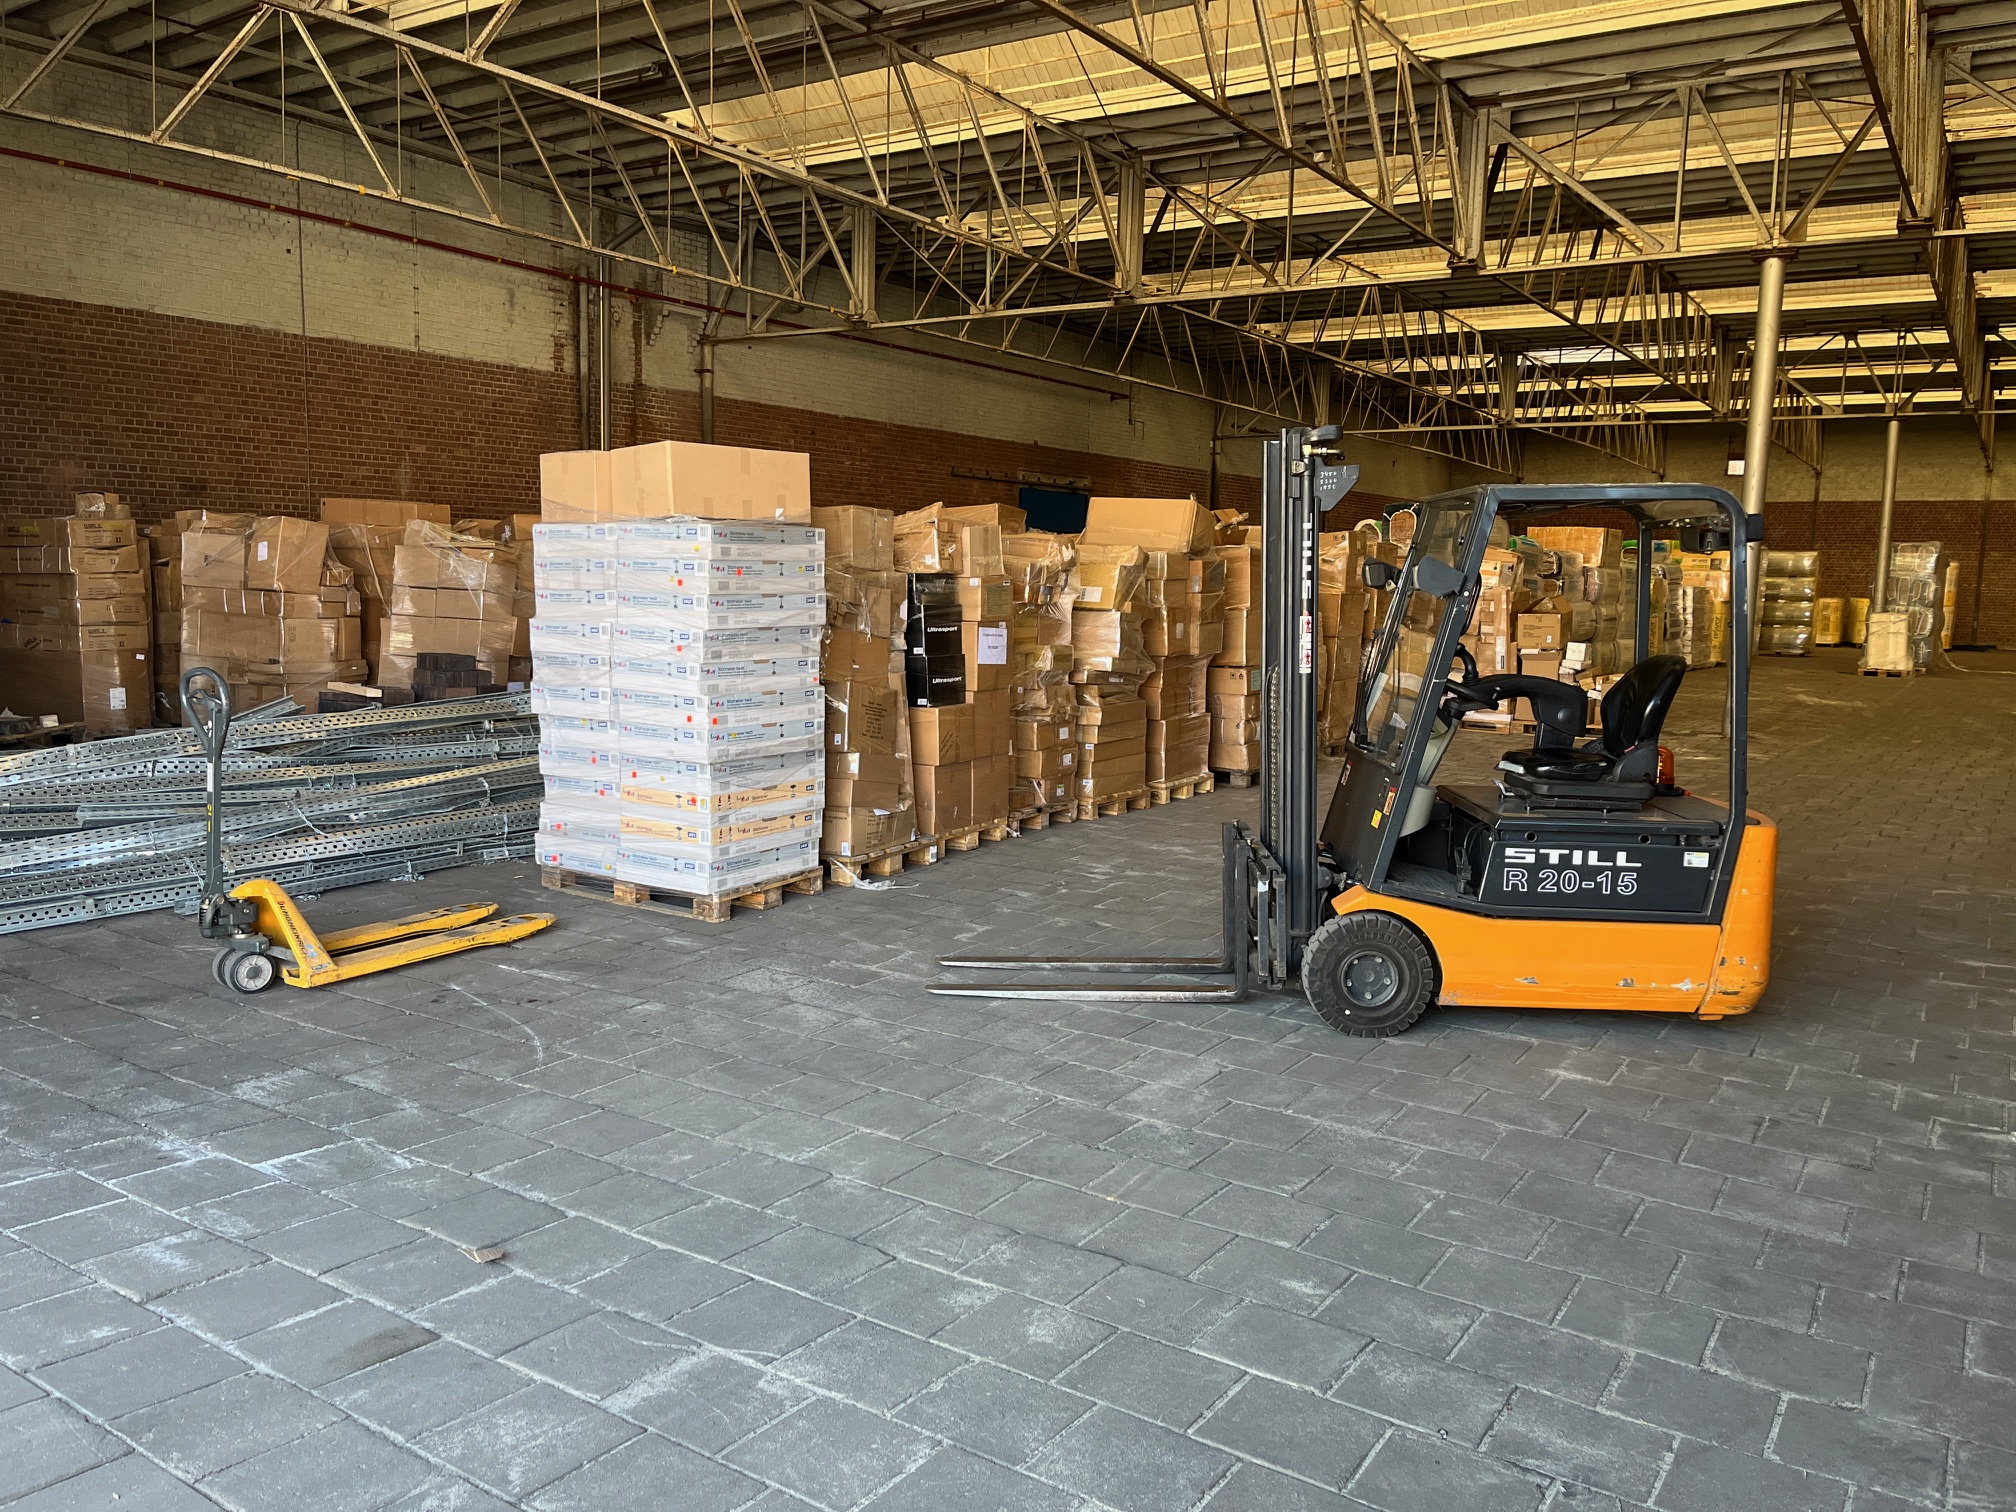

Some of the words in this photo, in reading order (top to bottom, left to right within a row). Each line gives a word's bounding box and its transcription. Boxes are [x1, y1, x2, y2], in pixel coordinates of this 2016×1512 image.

[1302, 513, 1312, 599] STILL
[932, 676, 963, 684] Ultrasport
[1504, 847, 1642, 867] STILL
[1503, 867, 1528, 892] R
[1537, 869, 1638, 896] 20-15
